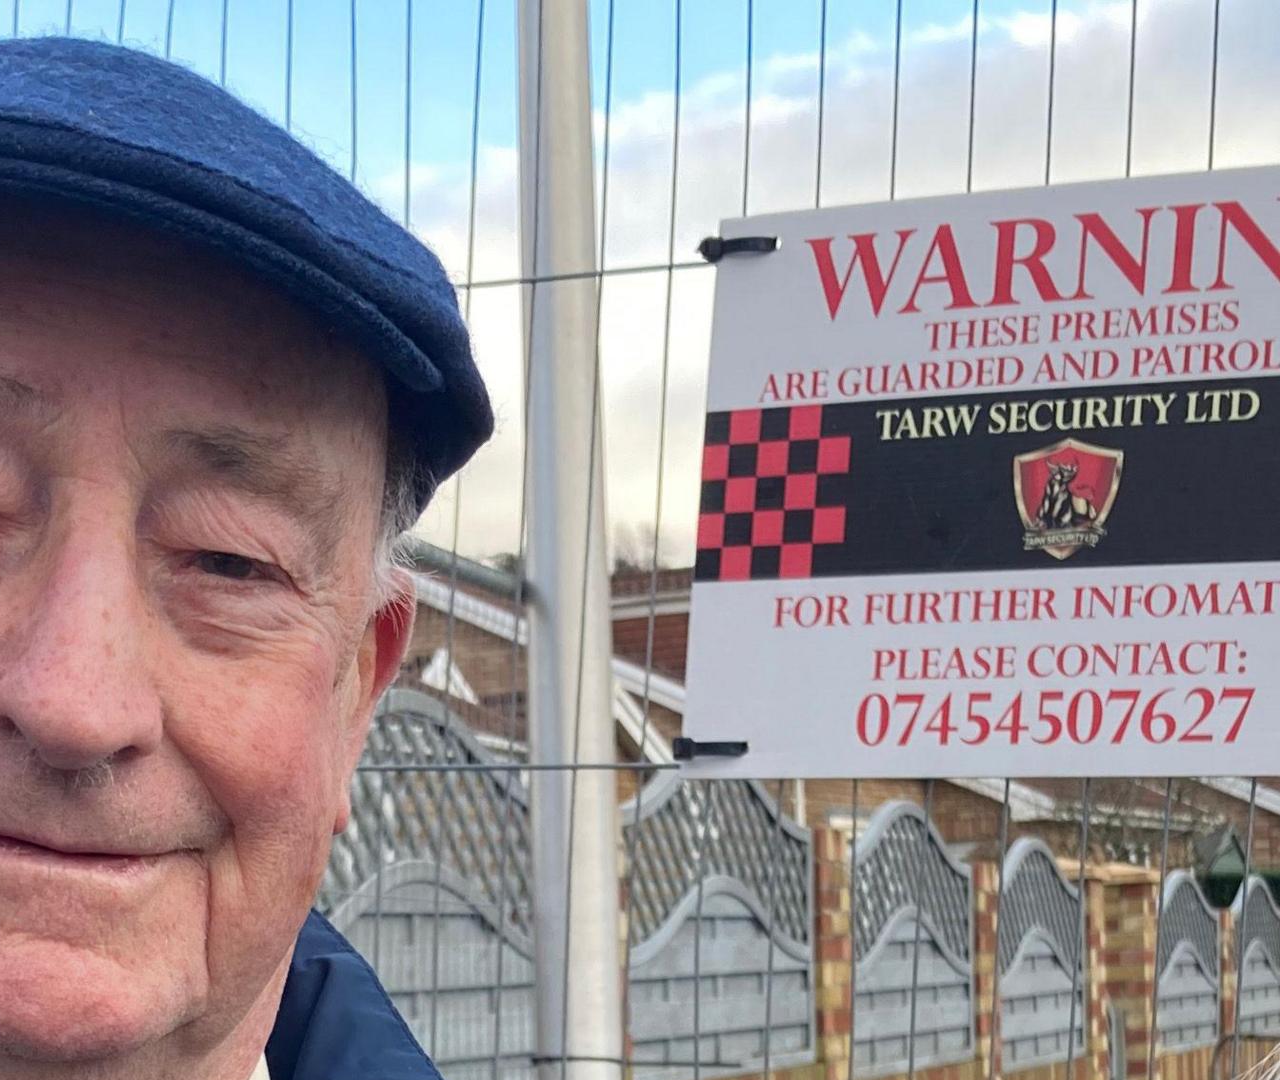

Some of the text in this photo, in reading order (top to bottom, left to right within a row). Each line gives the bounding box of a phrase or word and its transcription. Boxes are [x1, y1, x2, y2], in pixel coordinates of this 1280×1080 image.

[924, 299, 1240, 352] THESE PREMISES
[758, 369, 829, 402] ARE
[837, 354, 1025, 398] GUARDED
[1032, 349, 1120, 384] AND
[875, 387, 1261, 441] TARW SECURITY LTD
[773, 594, 852, 629] FOR
[863, 587, 1058, 625] FURTHER
[871, 639, 1248, 682] PLEASE CONTACT:
[855, 686, 1257, 748] 07454507627
